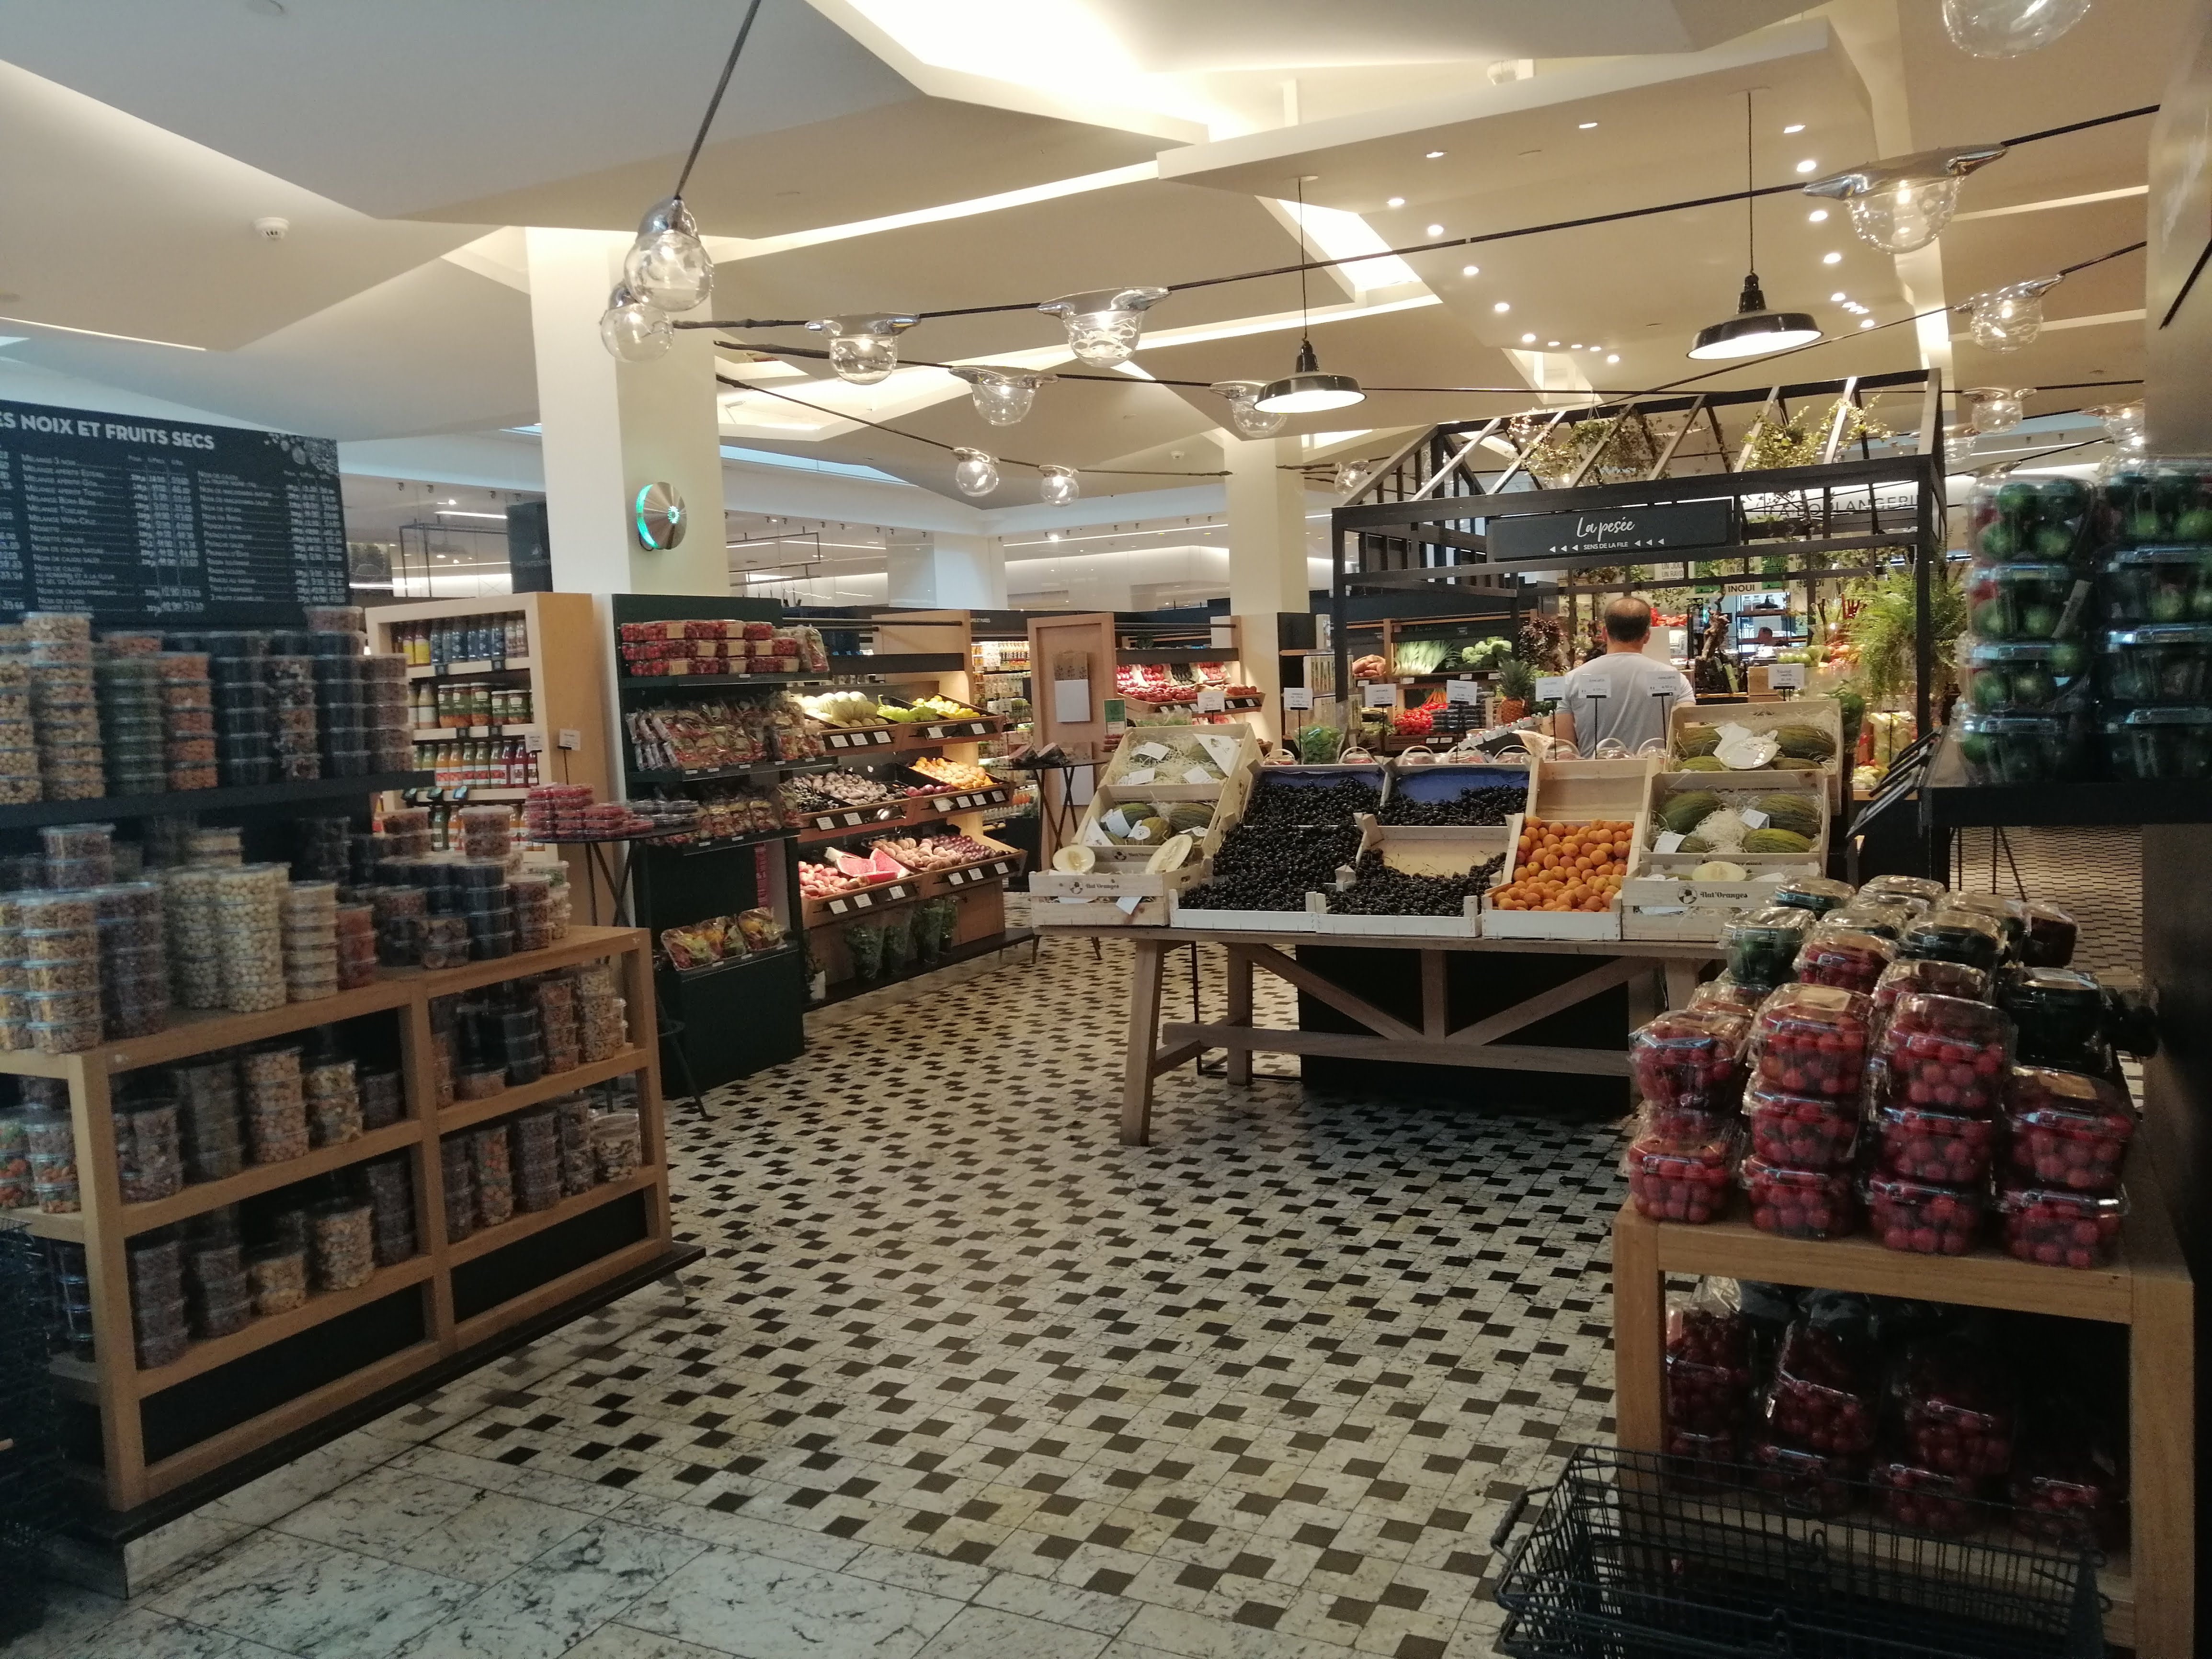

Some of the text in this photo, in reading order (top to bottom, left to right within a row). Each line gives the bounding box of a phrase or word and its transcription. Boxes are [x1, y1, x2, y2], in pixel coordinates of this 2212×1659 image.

[21, 414, 73, 434] NOIX
[77, 420, 101, 438] ET
[105, 424, 169, 445] FRUITS
[171, 431, 216, 450] SECS
[1577, 517, 1635, 542] La pesée
[1728, 584, 1755, 592] INOUI
